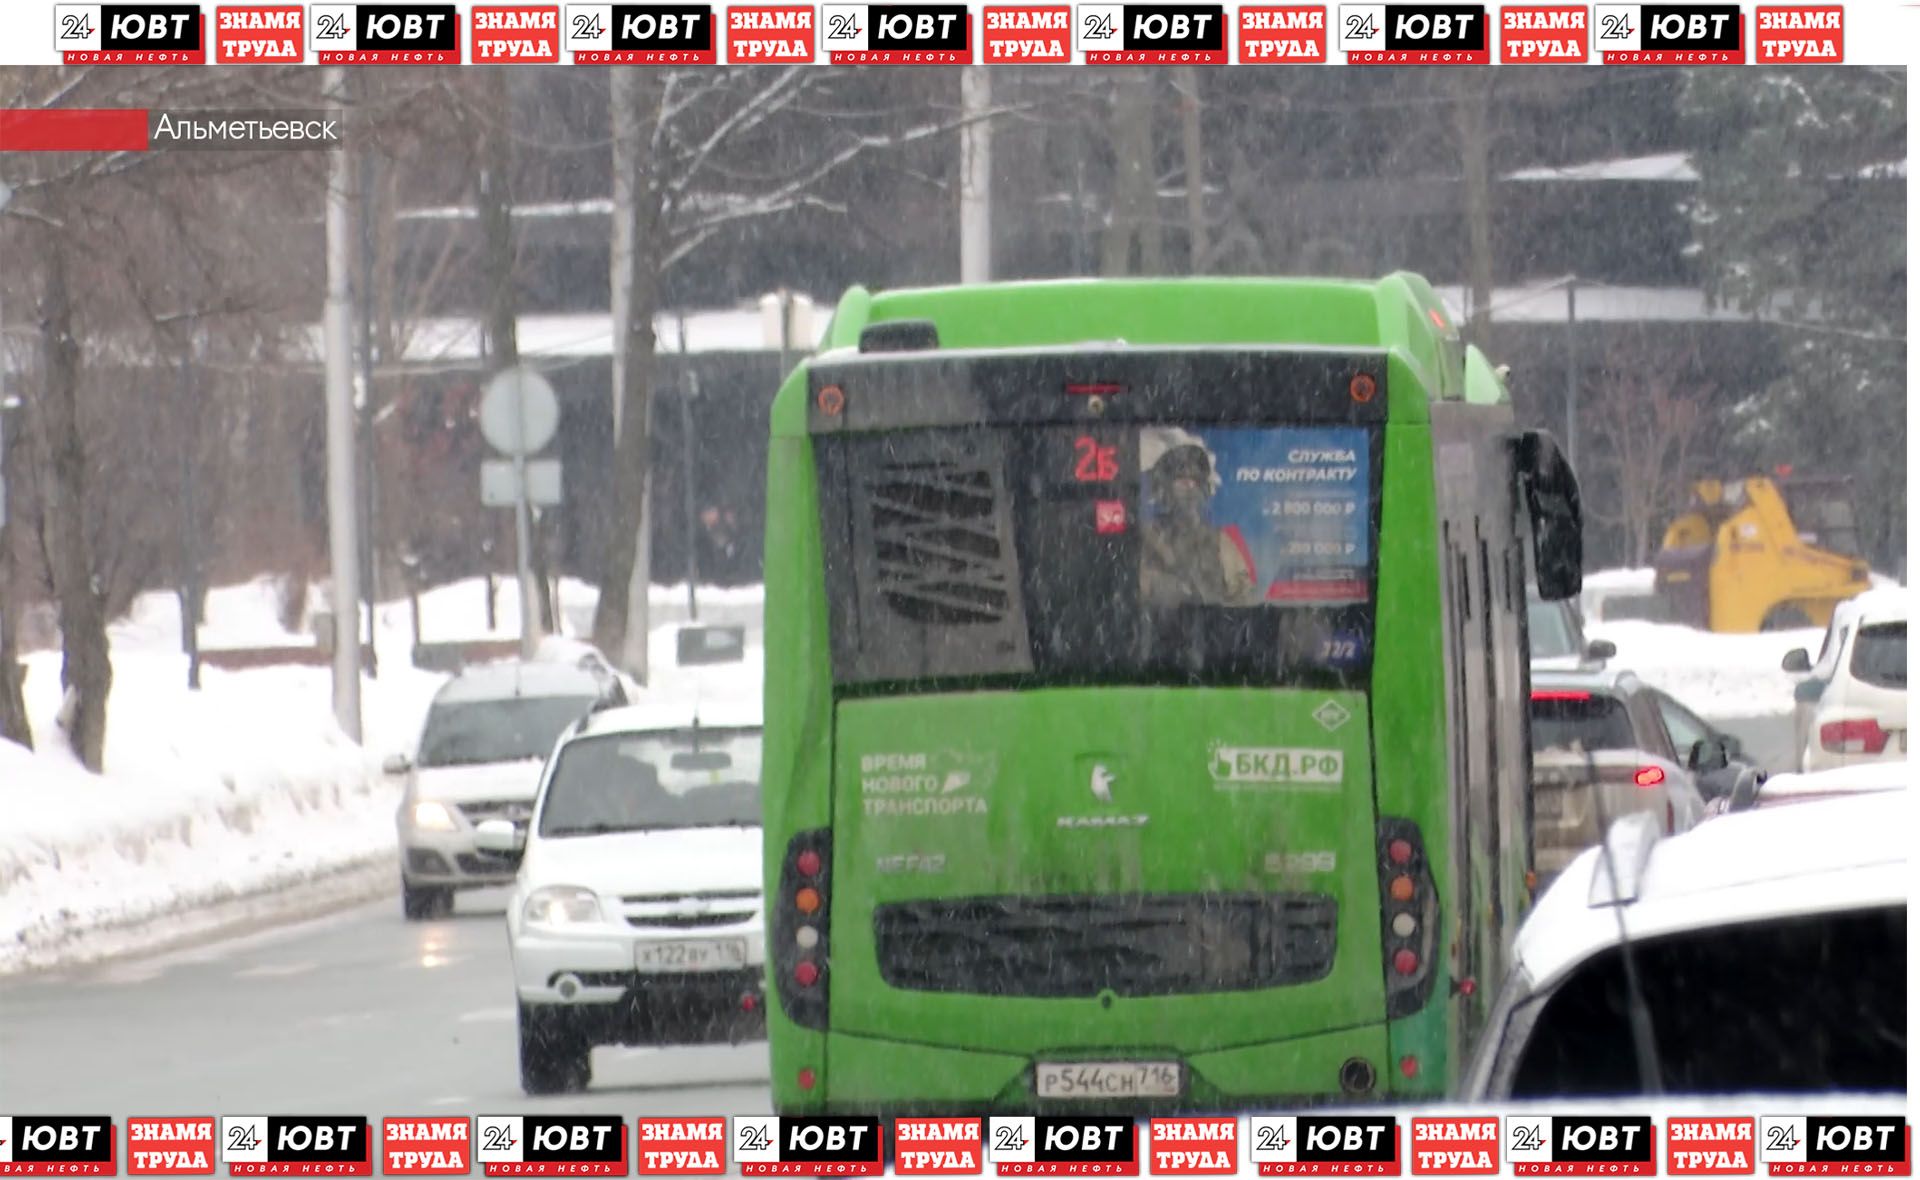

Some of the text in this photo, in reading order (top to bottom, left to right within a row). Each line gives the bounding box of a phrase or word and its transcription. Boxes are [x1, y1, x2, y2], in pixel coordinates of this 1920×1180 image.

[1287, 449, 1356, 464] СЛУЖБА
[1236, 466, 1357, 482] ПО КОНТРАКТУ
[861, 752, 926, 772] ВРЕМЯ
[1236, 753, 1339, 779] БКД.РФ
[862, 774, 937, 794] НОВОГО
[864, 797, 988, 816] ТРАНСПОРТА
